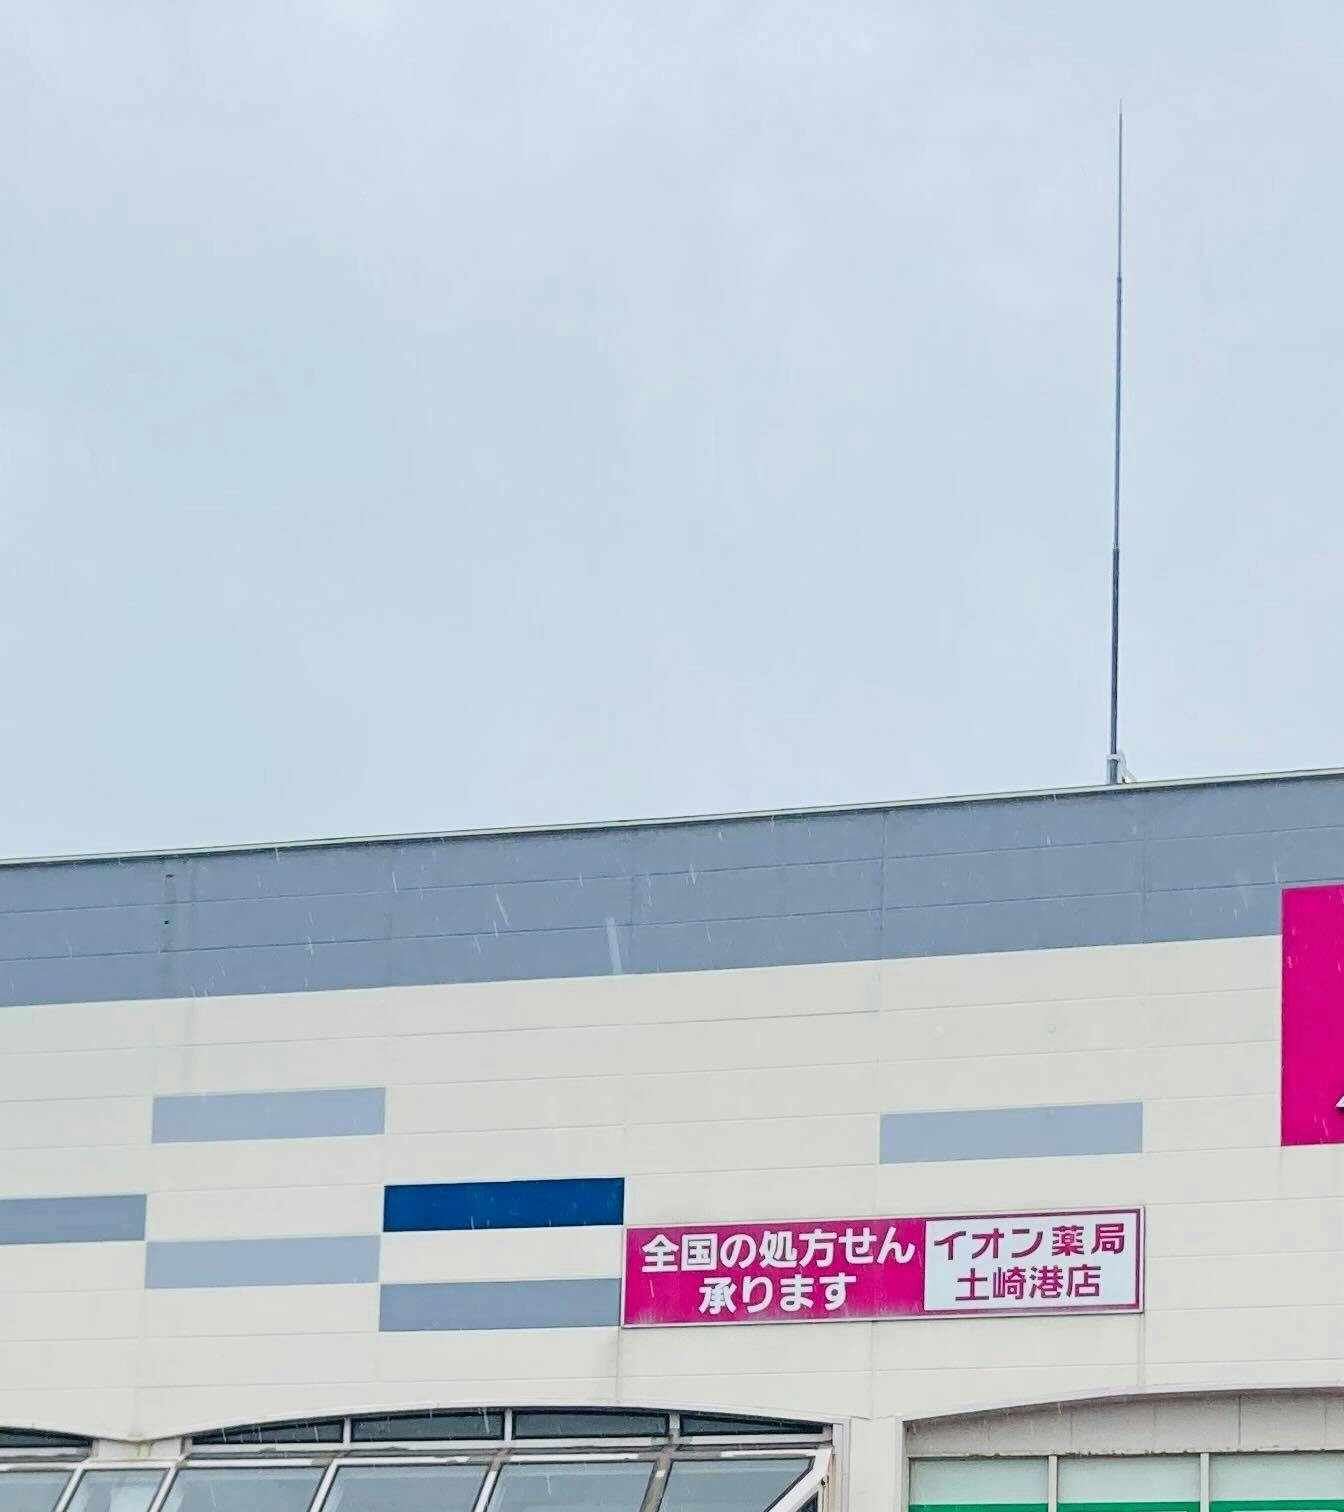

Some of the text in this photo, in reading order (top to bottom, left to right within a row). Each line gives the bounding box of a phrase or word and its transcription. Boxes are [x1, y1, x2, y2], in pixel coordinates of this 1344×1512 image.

[640, 1226, 917, 1273] 全国の処方せん
[932, 1222, 1126, 1260] イオン薬局
[698, 1272, 857, 1314] 承ります
[954, 1264, 1102, 1301] 土崎港店
